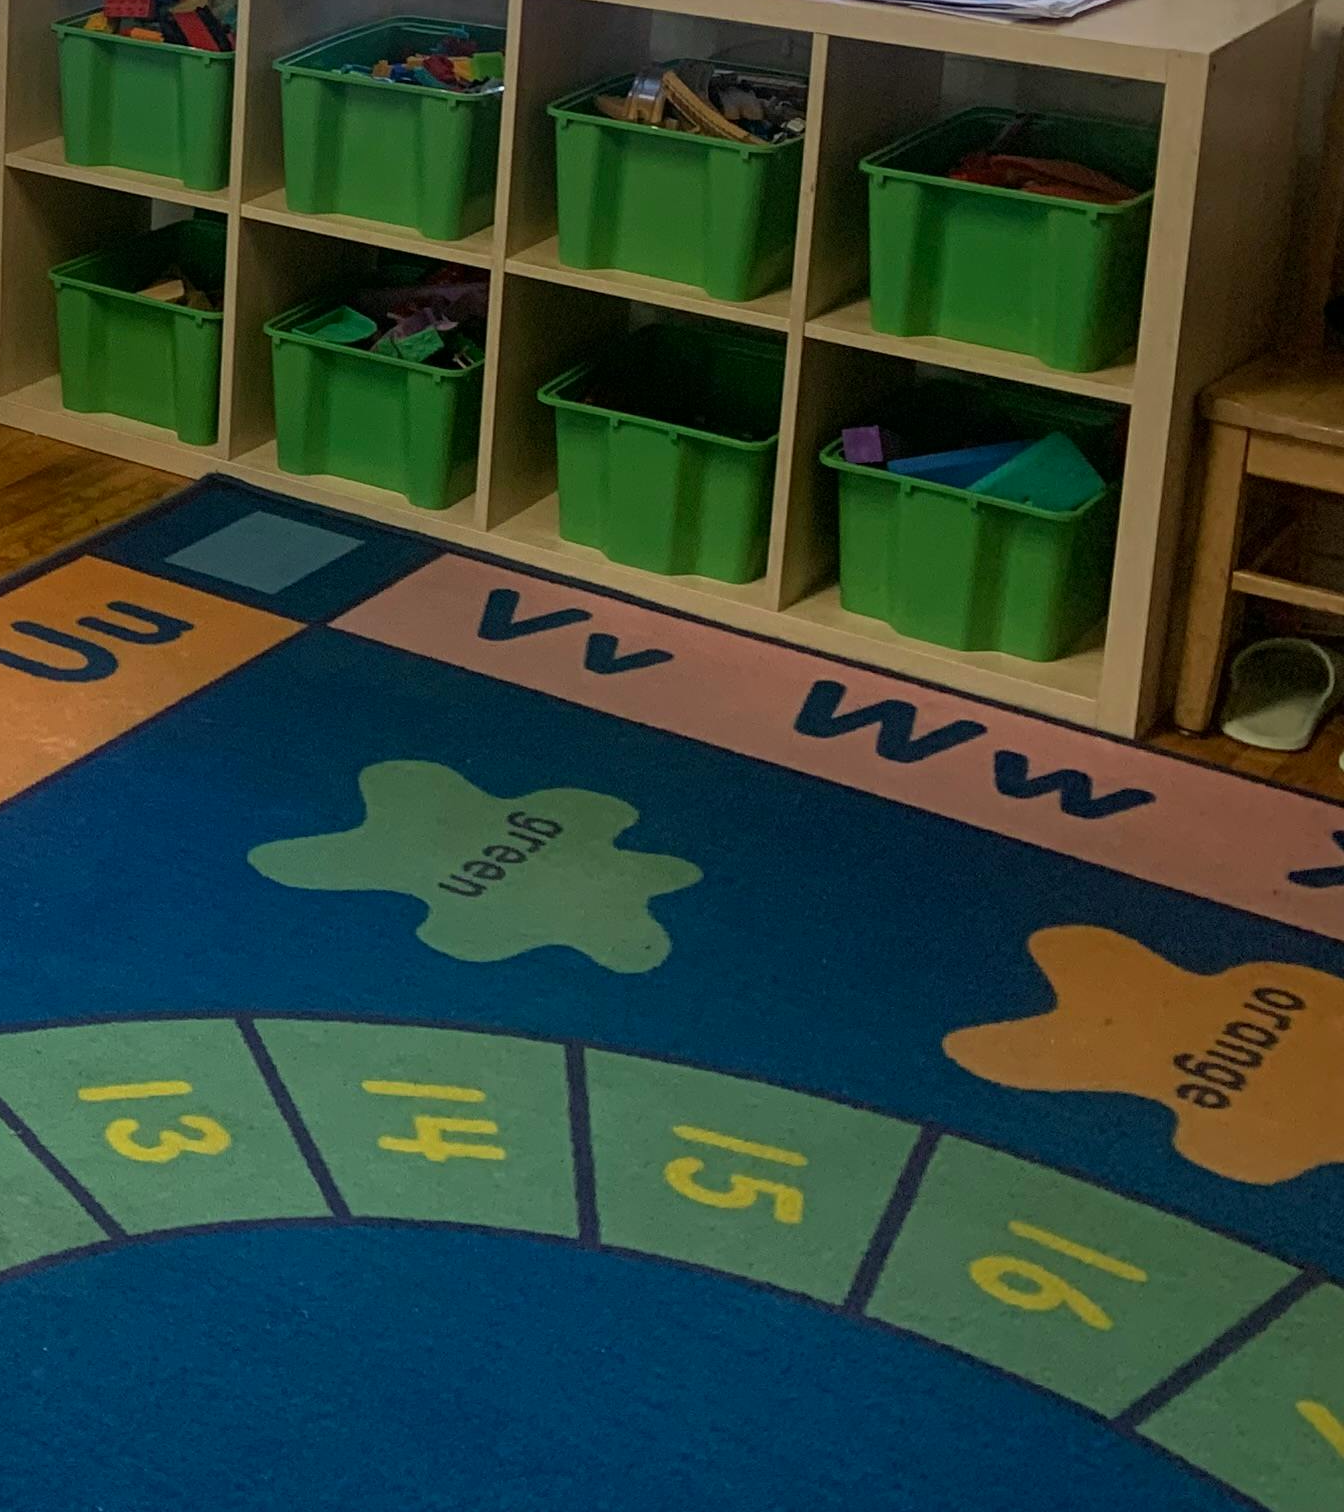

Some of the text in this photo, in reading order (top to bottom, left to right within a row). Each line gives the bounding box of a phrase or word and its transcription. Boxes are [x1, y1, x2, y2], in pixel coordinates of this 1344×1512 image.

[477, 587, 1156, 820] Vv Ww
[437, 810, 564, 898] green
[1173, 986, 1308, 1110] orange
[79, 1080, 231, 1163] 13
[361, 1080, 506, 1161] 14
[664, 1124, 808, 1226] 15
[968, 1221, 1149, 1331] 16
